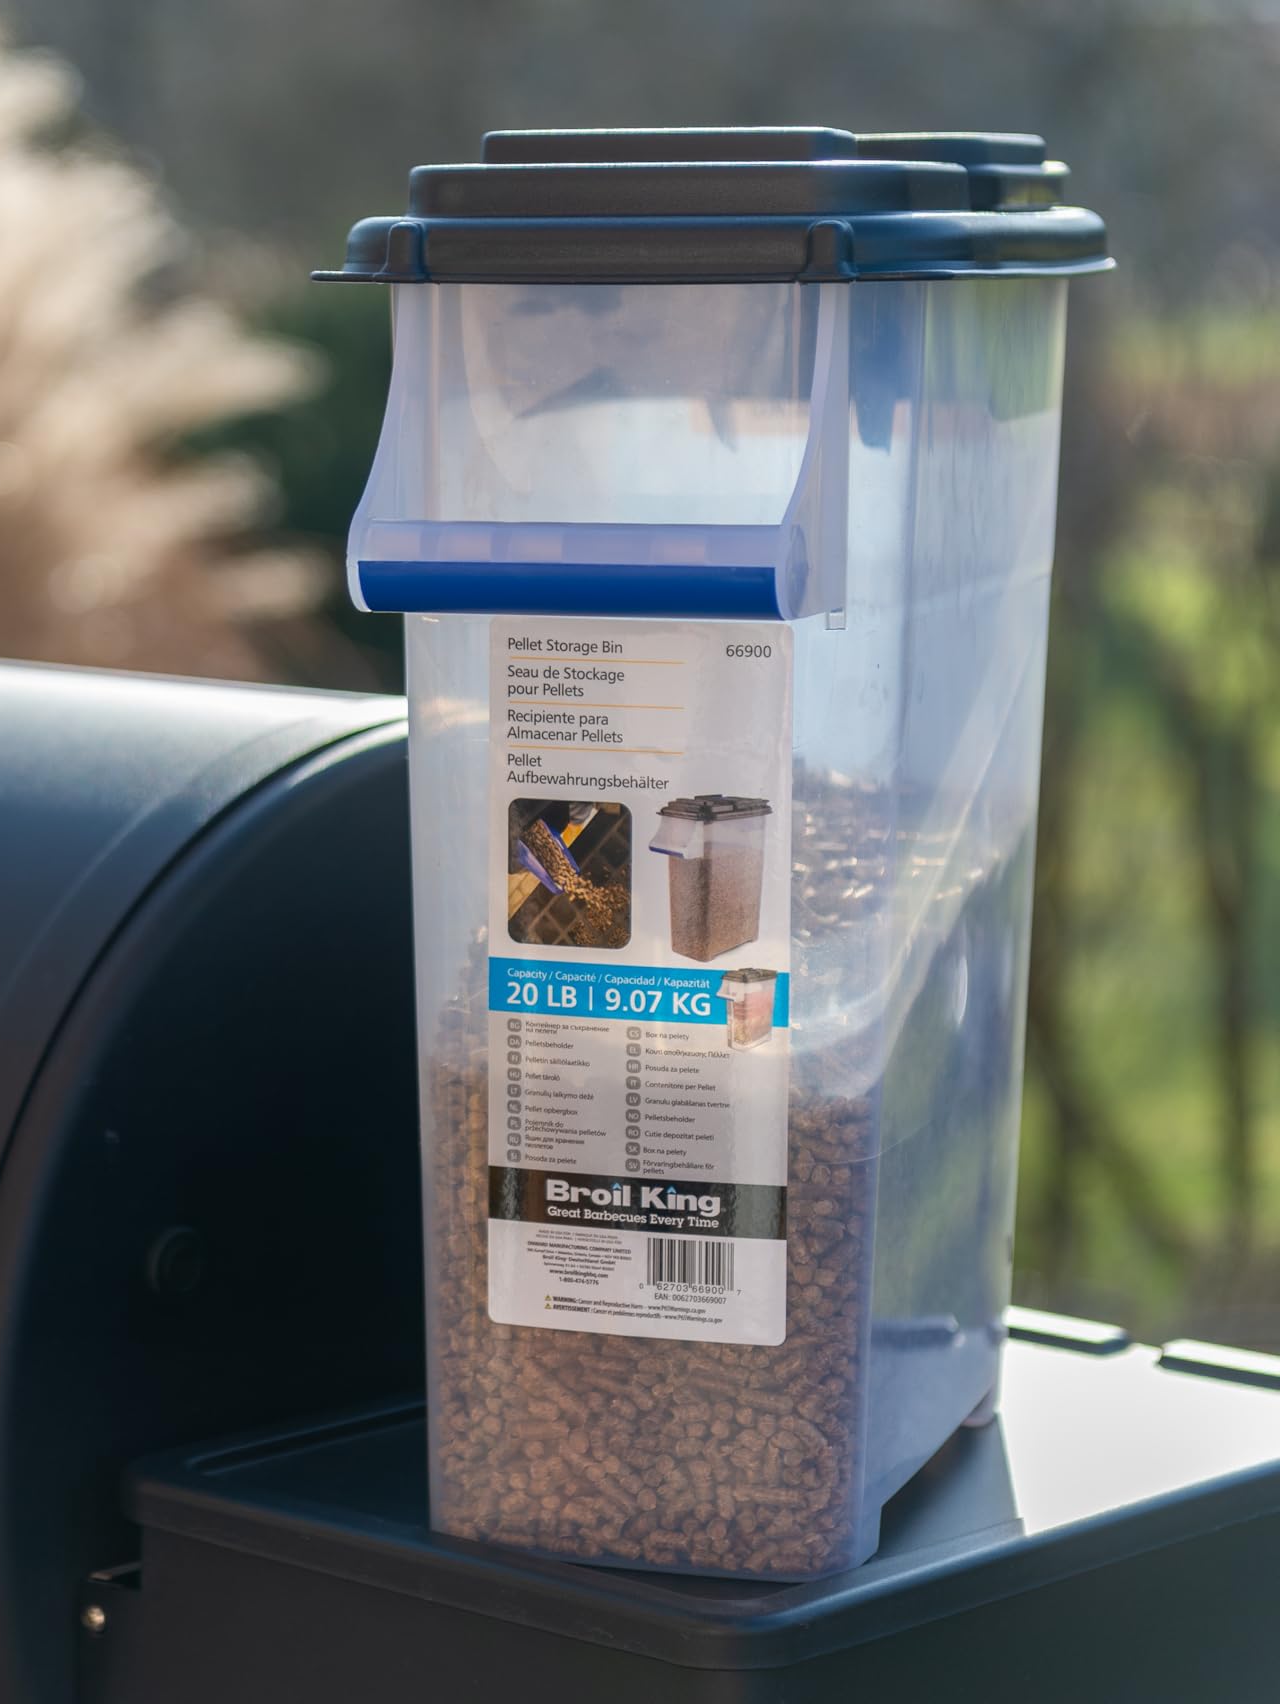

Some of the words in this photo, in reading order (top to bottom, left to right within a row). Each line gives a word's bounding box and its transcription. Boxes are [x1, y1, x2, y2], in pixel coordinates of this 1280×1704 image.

[507, 637, 542, 651] Pellet
[547, 638, 598, 656] Storage
[602, 640, 623, 654] Bin
[726, 644, 772, 658] 66900
[507, 665, 539, 679] Seau
[543, 665, 560, 679] de
[564, 666, 625, 684] Stockage
[507, 684, 539, 698] pour
[543, 683, 584, 697] Pellets
[507, 709, 575, 726] Recipiente
[579, 714, 609, 728] para
[507, 727, 577, 742] Almacenar
[581, 729, 623, 743] Pellets
[507, 753, 542, 767] Pellet
[507, 771, 669, 790] Aufbewahrungsbehälter
[507, 968, 547, 981] Capacity
[555, 970, 596, 983] Capacité
[605, 974, 655, 987] Capacidad
[664, 977, 710, 991] Kapazität
[506, 982, 539, 1006] 20
[547, 985, 577, 1008] LB
[605, 989, 663, 1013] 9.07
[672, 992, 711, 1016] KG
[525, 1040, 574, 1049] Pelletsbeholder
[645, 1080, 684, 1089] Contenitore
[645, 1114, 695, 1123] Pelletsbeholder
[643, 1167, 664, 1175] pellets
[545, 1179, 631, 1208] Broil
[640, 1185, 721, 1217] King
[547, 1206, 581, 1219] Great
[584, 1208, 647, 1225] Barbecues
[650, 1212, 685, 1228] Every
[687, 1215, 719, 1229] Time
[657, 1282, 689, 1292] 62703
[691, 1285, 724, 1295] 66900
